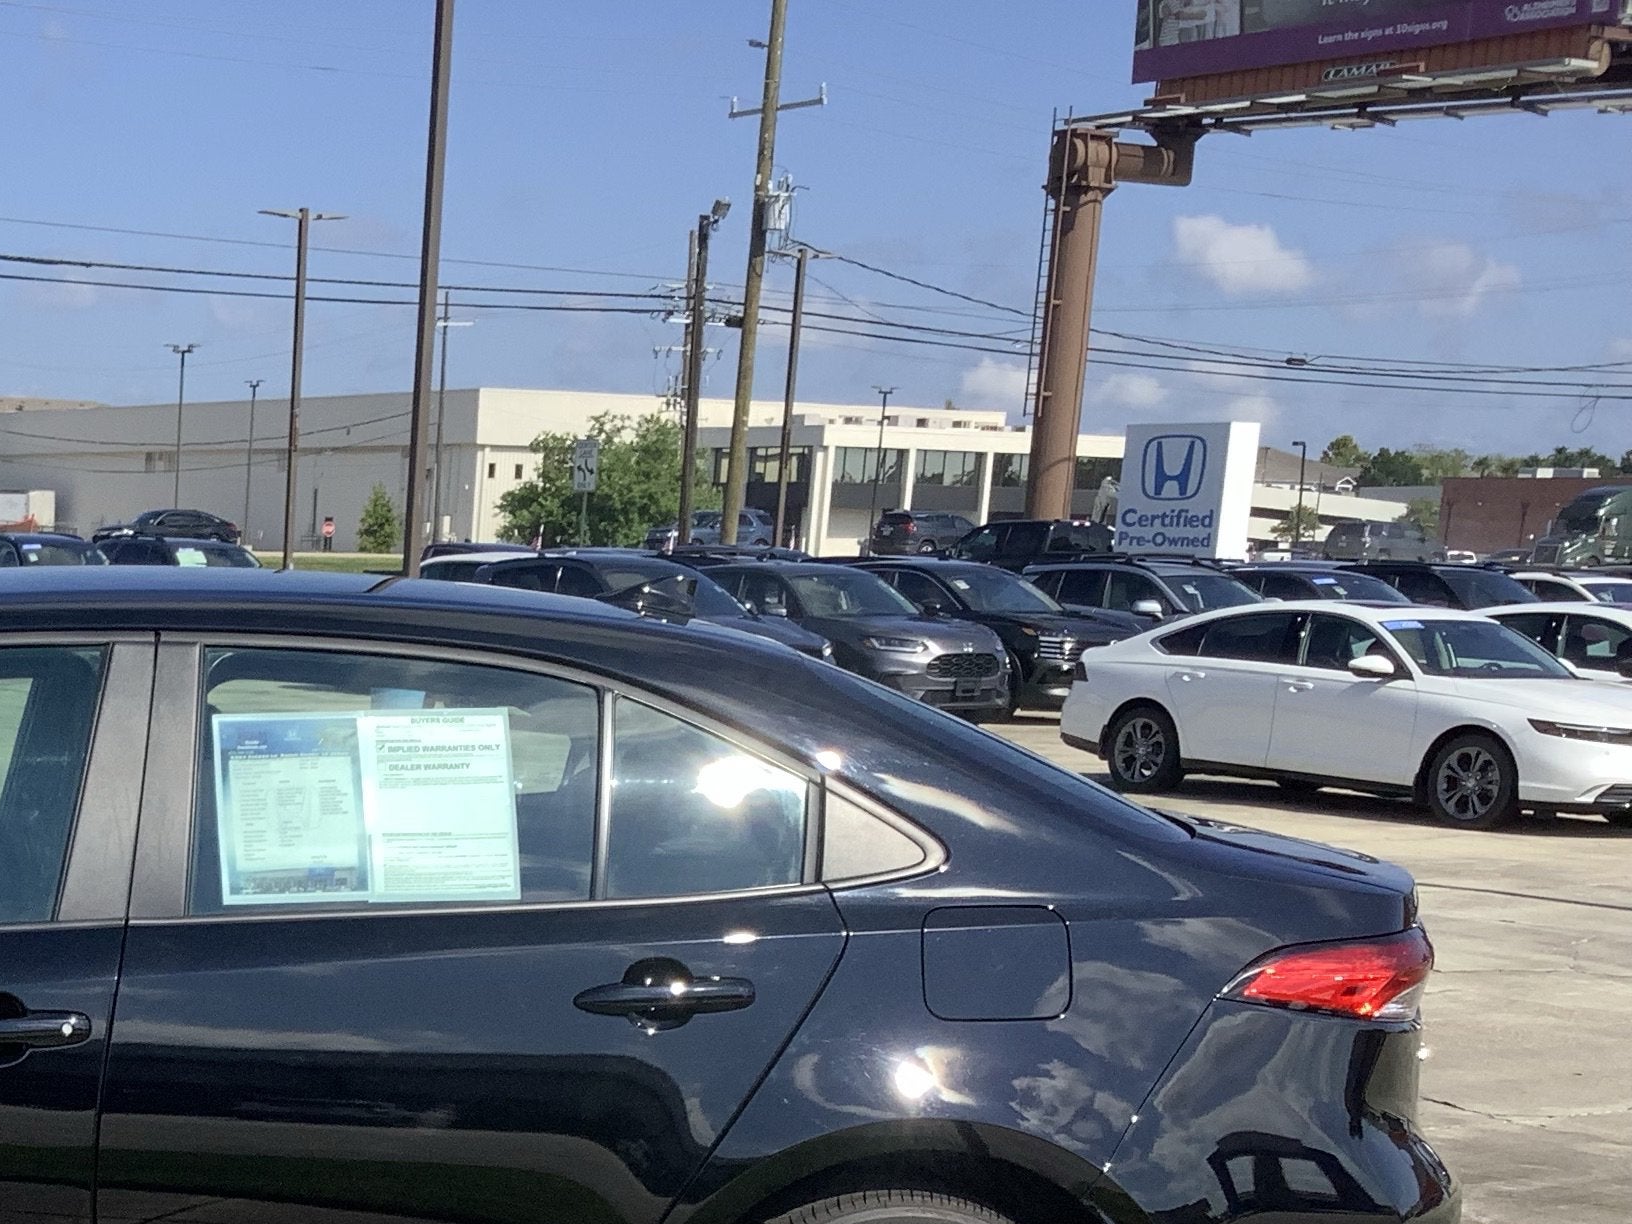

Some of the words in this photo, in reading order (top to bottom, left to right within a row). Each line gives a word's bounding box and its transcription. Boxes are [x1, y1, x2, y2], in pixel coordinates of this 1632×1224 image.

[1318, 33, 1343, 45] Learn
[1344, 30, 1359, 41] the
[1384, 26, 1394, 36] at
[1121, 508, 1214, 529] Certified
[1118, 531, 1212, 548] Pre-Owned
[442, 716, 465, 724] GUIDE
[387, 745, 420, 753] IMPLIED
[422, 744, 476, 752] WARRANTIES
[478, 743, 501, 751] ONLY
[388, 763, 422, 771] DEALER
[423, 762, 471, 770] WARRANTY
